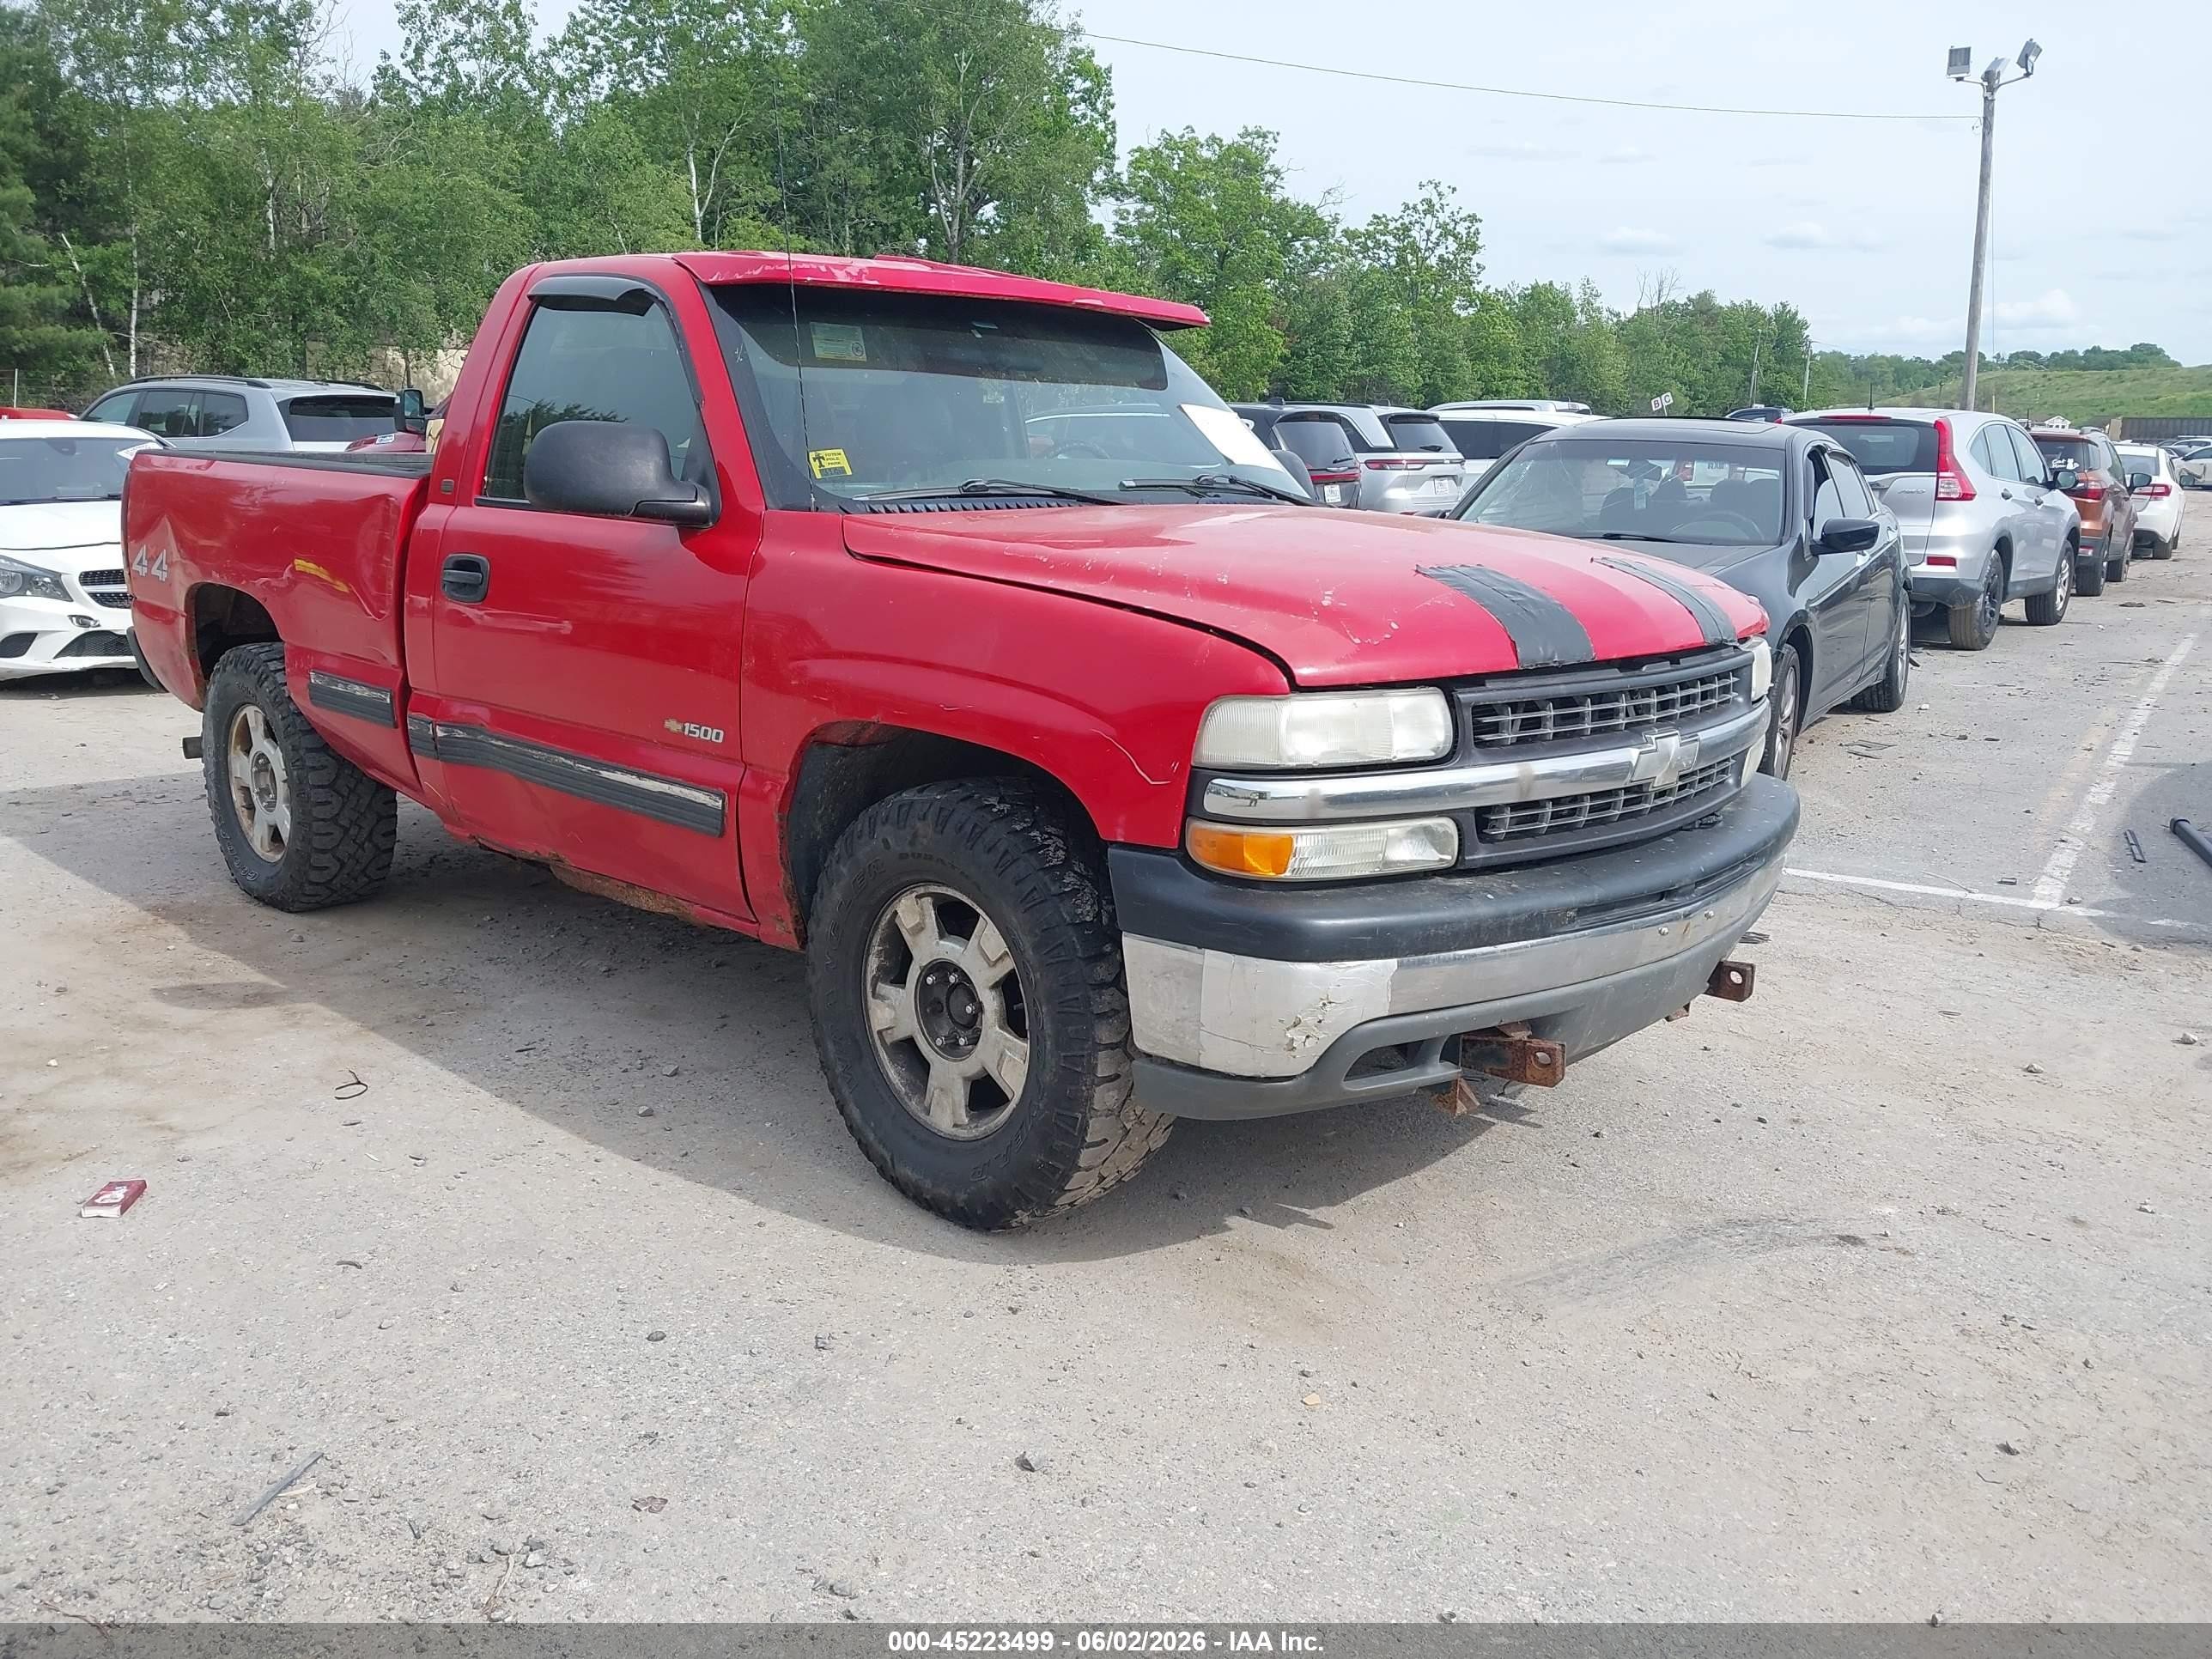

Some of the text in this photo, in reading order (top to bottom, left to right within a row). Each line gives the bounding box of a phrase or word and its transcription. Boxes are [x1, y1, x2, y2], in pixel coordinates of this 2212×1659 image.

[1653, 399, 1660, 409] B
[1663, 394, 1671, 404] C
[684, 723, 724, 744] 1500
